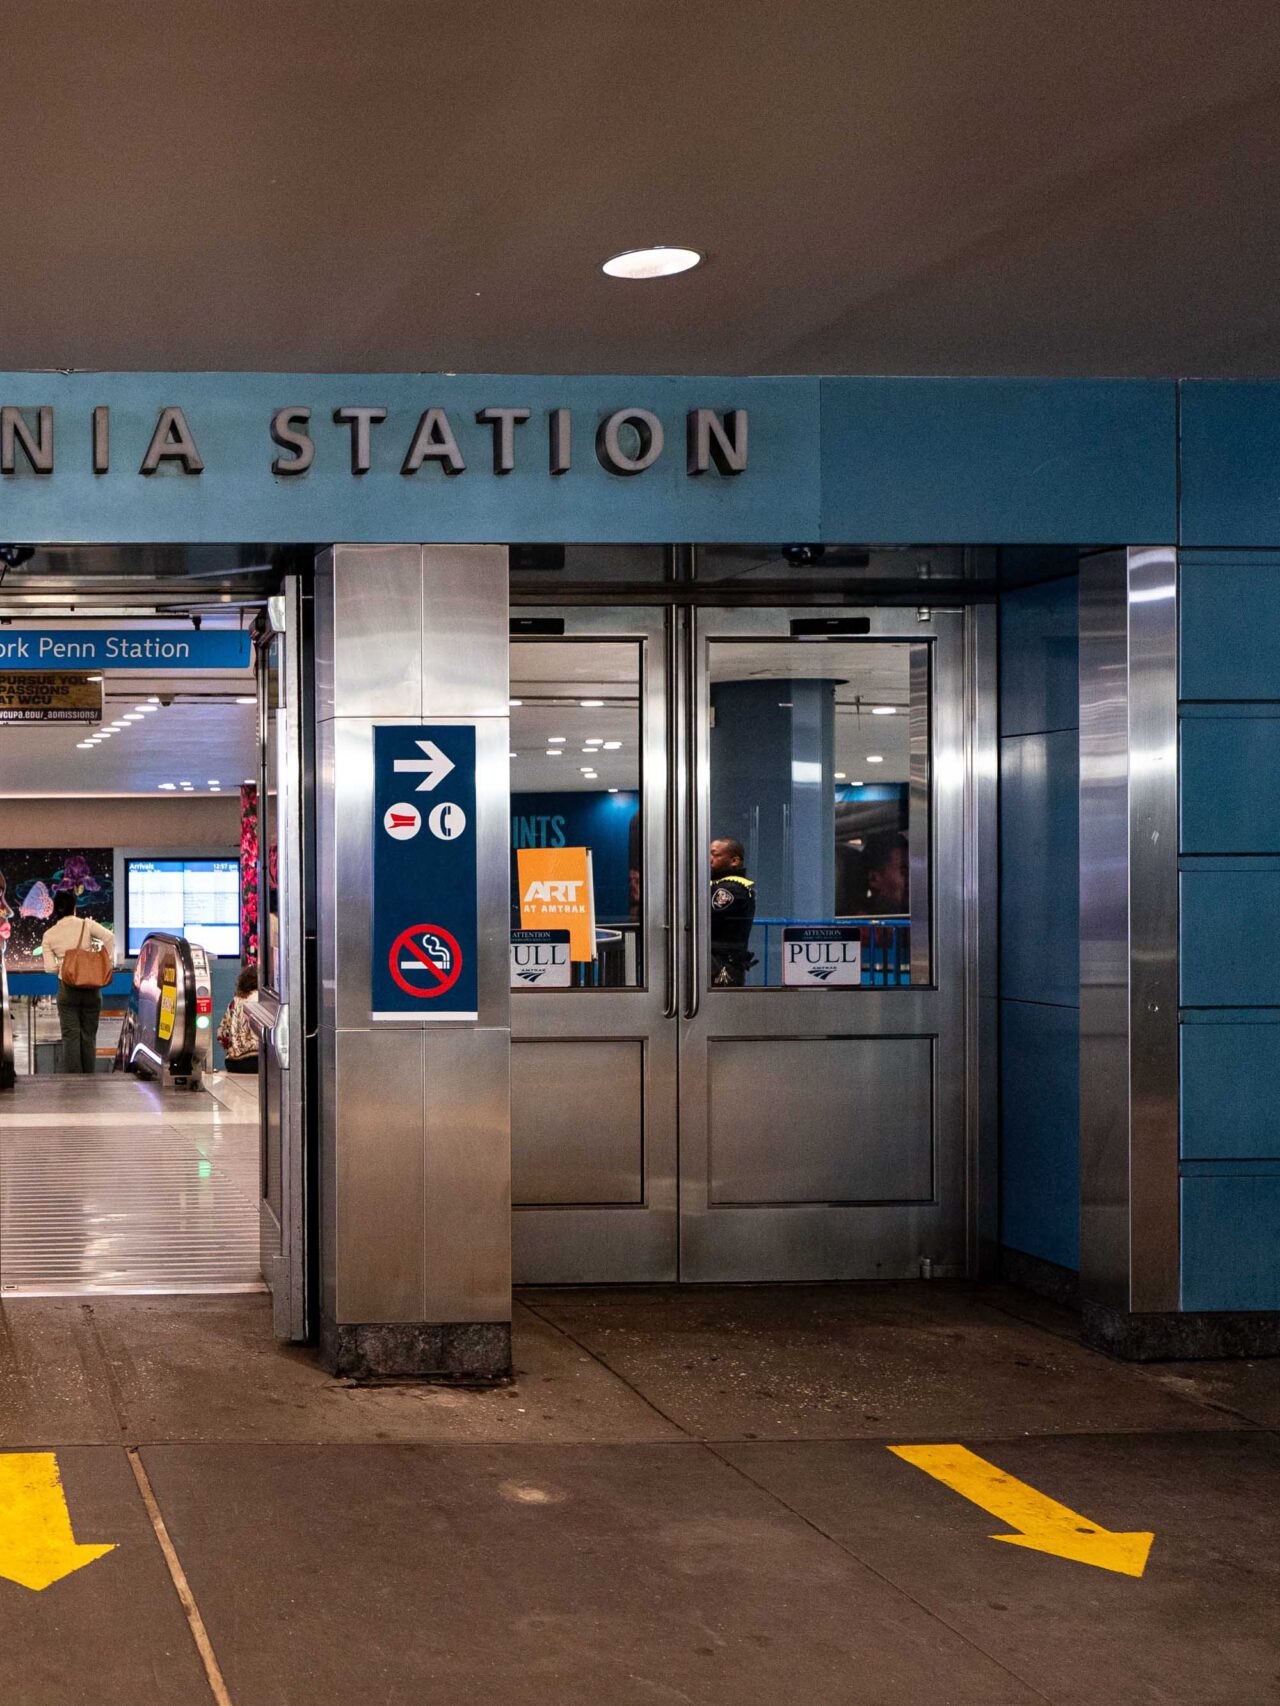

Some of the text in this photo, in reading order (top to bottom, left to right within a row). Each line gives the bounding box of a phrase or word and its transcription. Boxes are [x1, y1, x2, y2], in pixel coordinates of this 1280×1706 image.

[271, 406, 748, 476] STATION
[40, 637, 96, 658] Penn
[105, 637, 190, 658] Station
[18, 695, 52, 705] WCU
[523, 880, 584, 903] ART
[523, 903, 586, 913] AT AMTRAK
[511, 945, 566, 966] ULL
[789, 943, 857, 964] PULL
